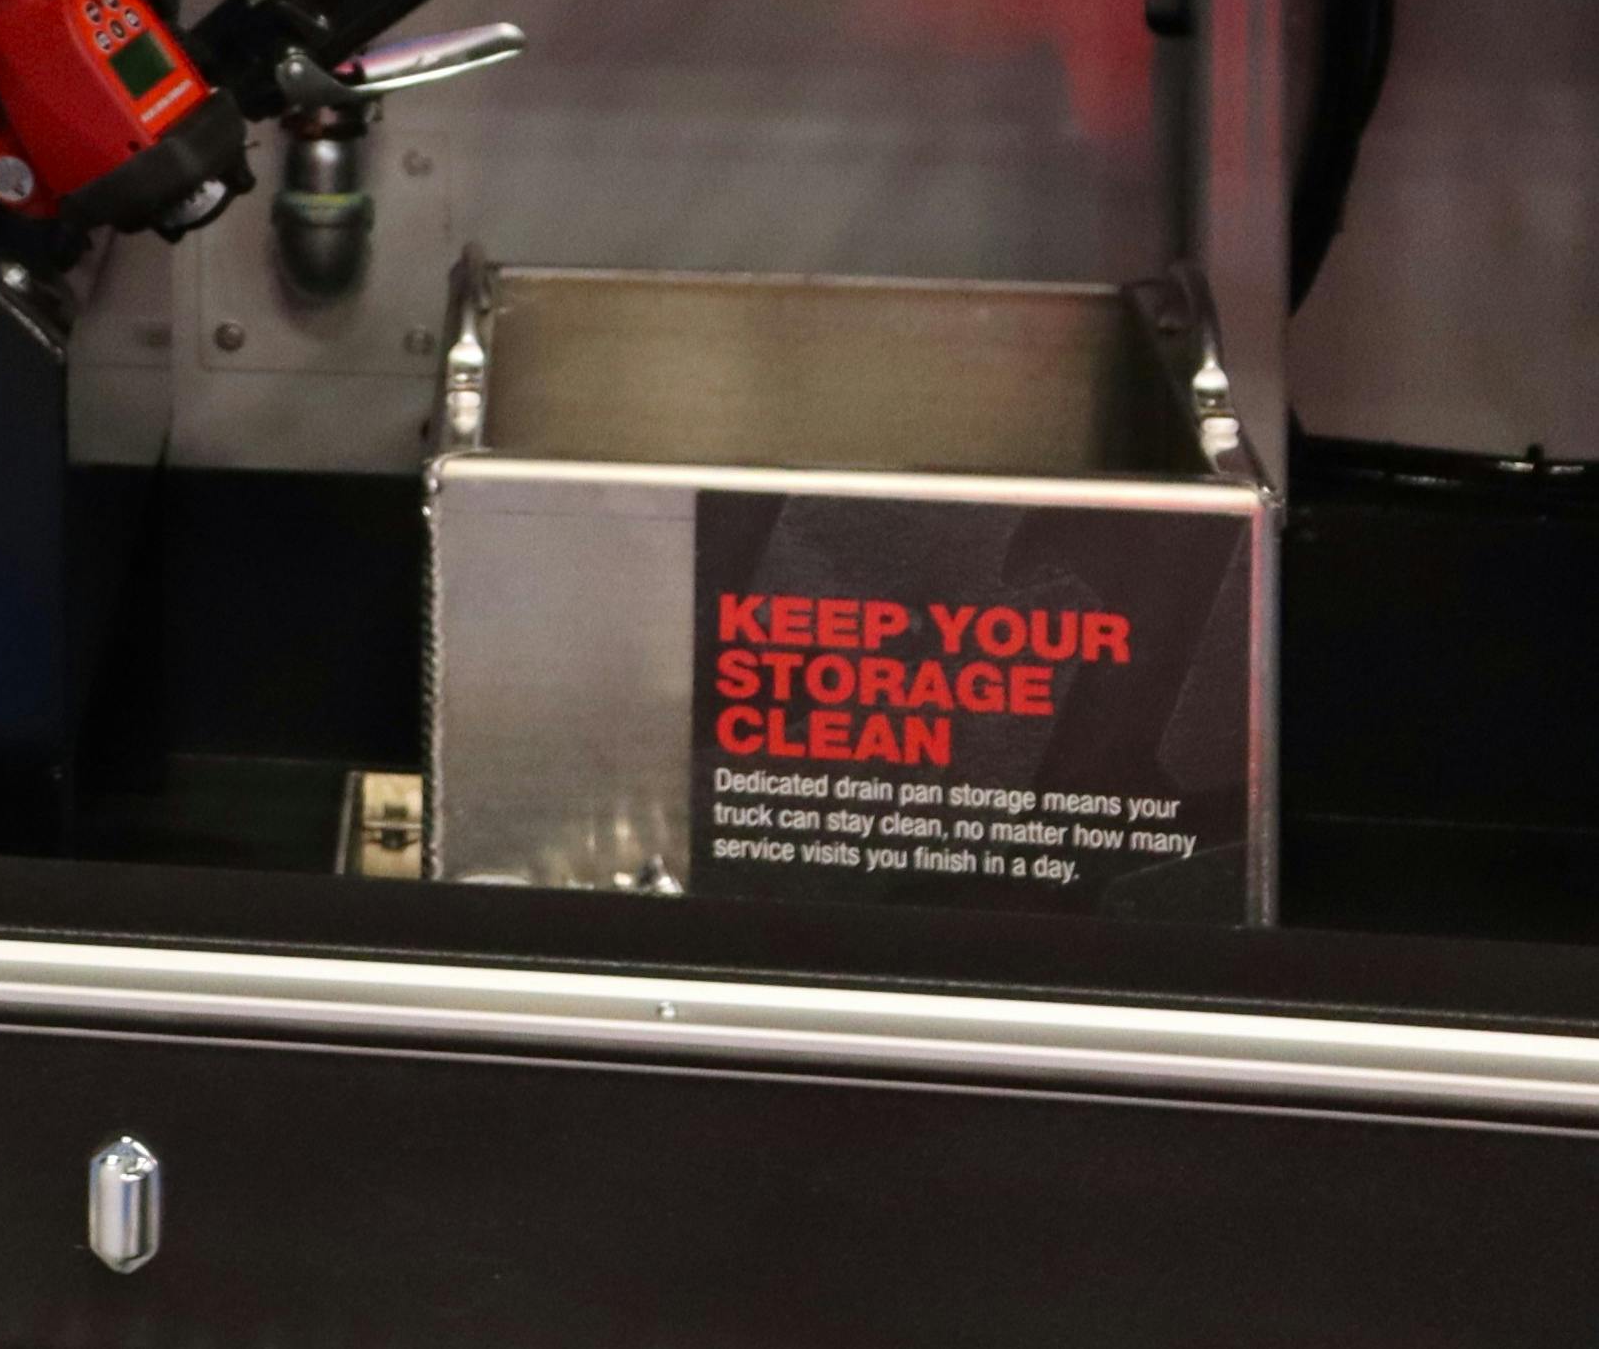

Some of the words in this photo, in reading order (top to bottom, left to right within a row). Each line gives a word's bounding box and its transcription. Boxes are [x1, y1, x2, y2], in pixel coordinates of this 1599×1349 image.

[718, 593, 910, 650] KEEP
[928, 603, 1132, 664] YOUR
[715, 648, 1055, 716] STORAGE
[715, 705, 952, 766] CLEAN
[714, 767, 829, 797] Dedicated
[833, 776, 893, 801] drain
[899, 783, 943, 807] pan
[950, 783, 1036, 815] storage
[1042, 792, 1122, 816] means
[1128, 798, 1181, 822] your
[714, 802, 773, 827] truck
[778, 808, 821, 830] can
[826, 810, 875, 838] stay
[879, 812, 949, 841] clean,
[955, 819, 984, 840] no
[990, 821, 1068, 846] matter
[1073, 823, 1124, 849] how
[1129, 830, 1198, 859] many
[714, 837, 795, 862] service
[802, 840, 860, 866] visits
[866, 848, 908, 872] you
[913, 846, 977, 874] finish
[983, 851, 1006, 874] in
[1010, 857, 1027, 877] a
[1032, 854, 1080, 885] day.
